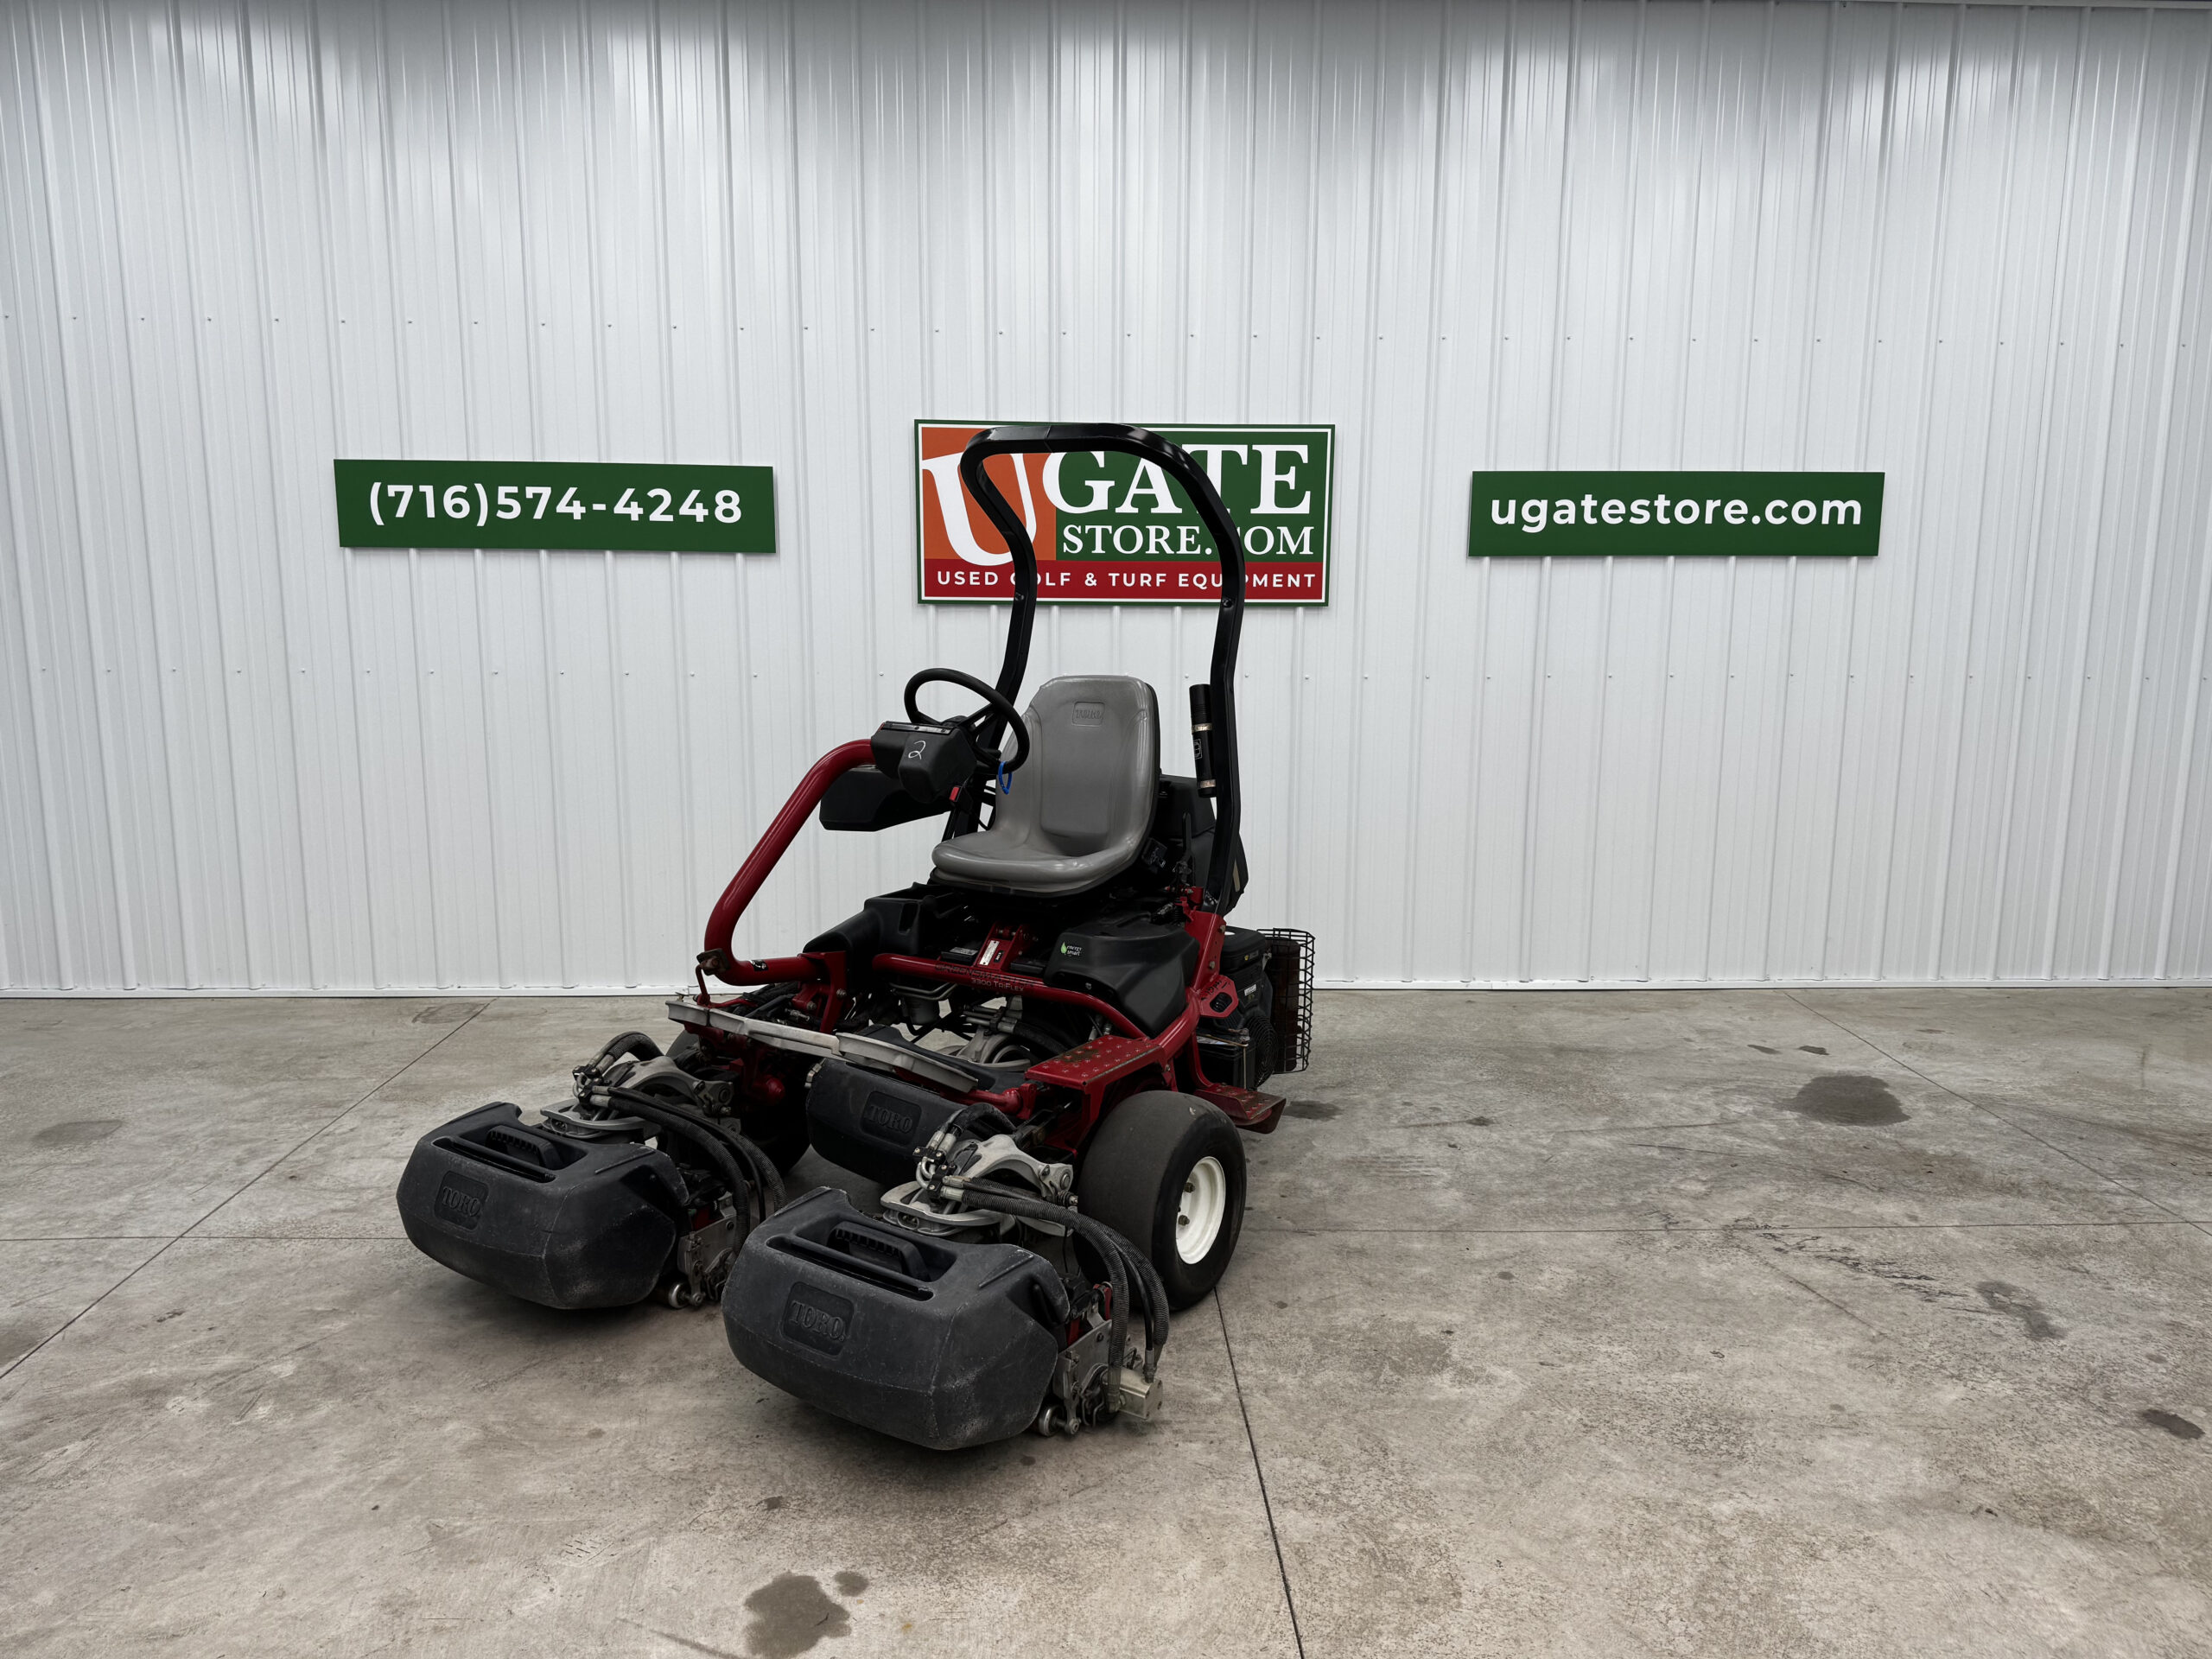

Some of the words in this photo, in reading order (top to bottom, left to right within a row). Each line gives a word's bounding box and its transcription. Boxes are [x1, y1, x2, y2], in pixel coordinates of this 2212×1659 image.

[370, 482, 742, 527] (716)574-4248
[1491, 493, 1862, 533] ugatestore.com
[1063, 524, 1314, 556] STORE.OM
[938, 570, 999, 586] USED
[1010, 571, 1071, 587] LF
[1084, 572, 1097, 587] &
[1109, 573, 1166, 588] TURF
[1178, 573, 1316, 589] EQUMENT
[908, 740, 926, 760] 2
[971, 978, 992, 987] 3300
[868, 1104, 913, 1135] TORO
[442, 1185, 481, 1217] TORO
[788, 1299, 844, 1340] TORO
